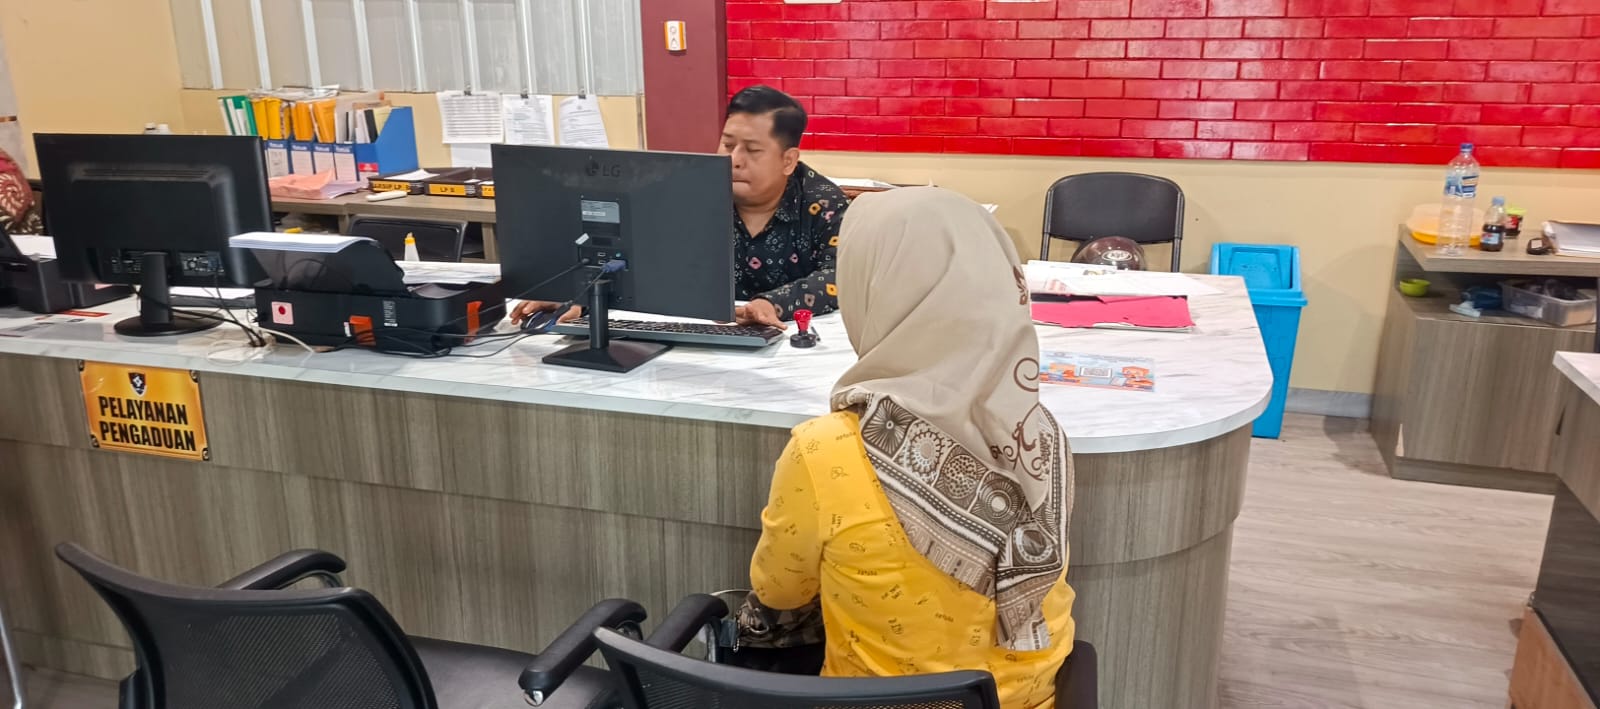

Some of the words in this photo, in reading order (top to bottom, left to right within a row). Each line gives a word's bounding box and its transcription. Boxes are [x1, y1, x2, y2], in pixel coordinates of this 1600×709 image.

[602, 164, 621, 178] LG
[98, 396, 188, 425] PELAYANAN
[99, 421, 196, 451] PENGADUAN
